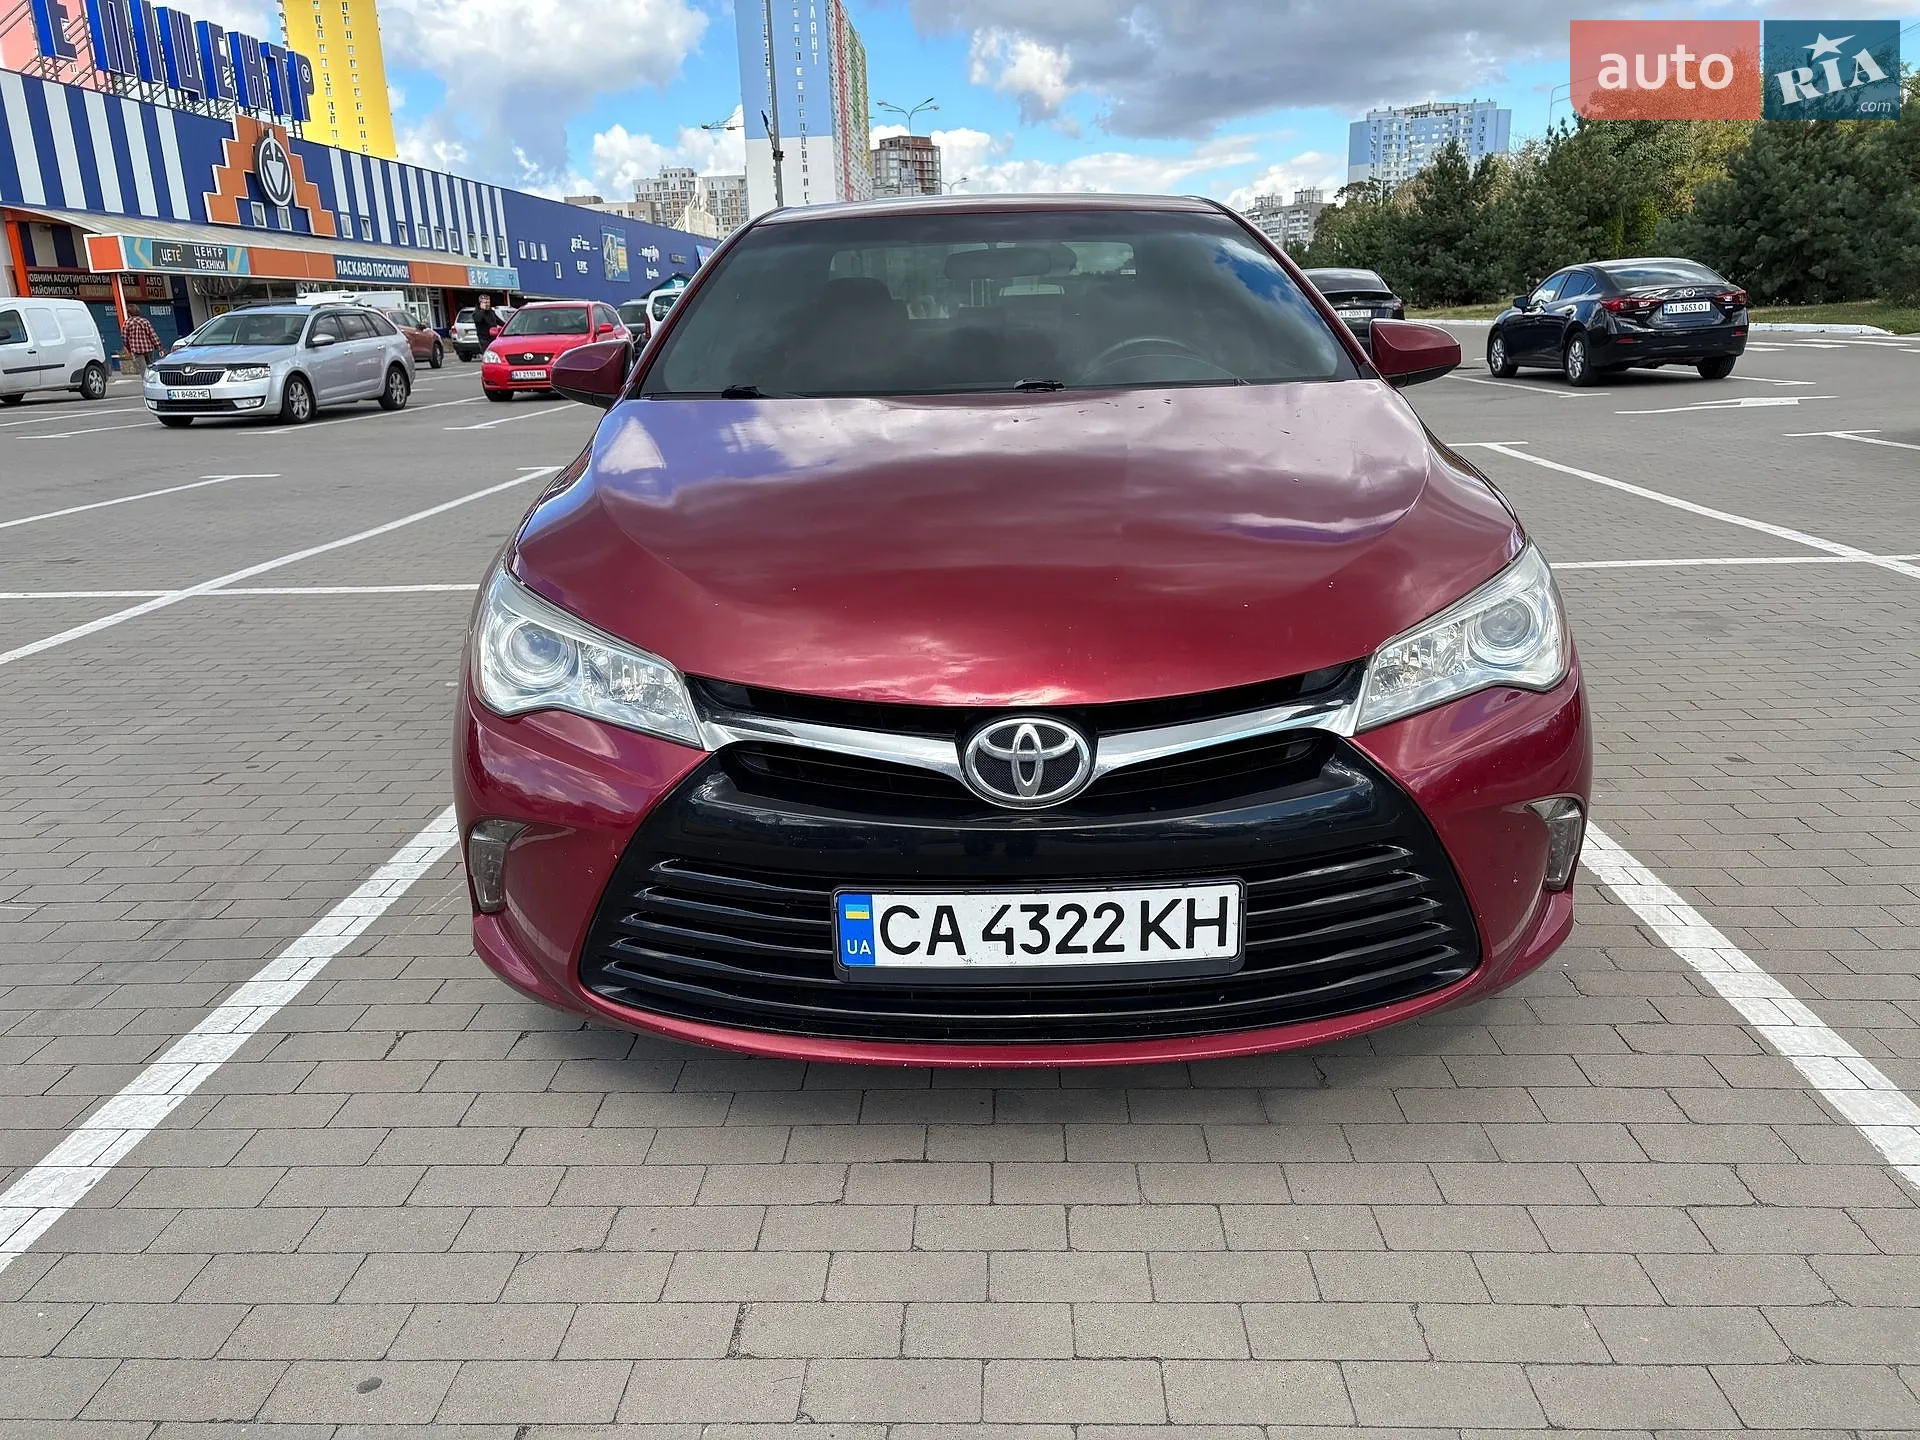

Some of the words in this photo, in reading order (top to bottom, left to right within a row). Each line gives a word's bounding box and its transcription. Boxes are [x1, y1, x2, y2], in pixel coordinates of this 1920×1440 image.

[194, 246, 223, 258] ЦЕНТР
[196, 259, 226, 270] ТЕХНІКИ
[336, 260, 372, 277] ЛАСКАВО
[372, 263, 410, 279] ПРОСИМО!
[29, 274, 53, 283] ОВНИМ
[1668, 305, 1678, 313] AI
[1680, 304, 1697, 312] 3653
[879, 904, 967, 956] CA
[981, 901, 1126, 956] 4322
[1139, 895, 1229, 951] KH
[847, 939, 872, 956] UA
